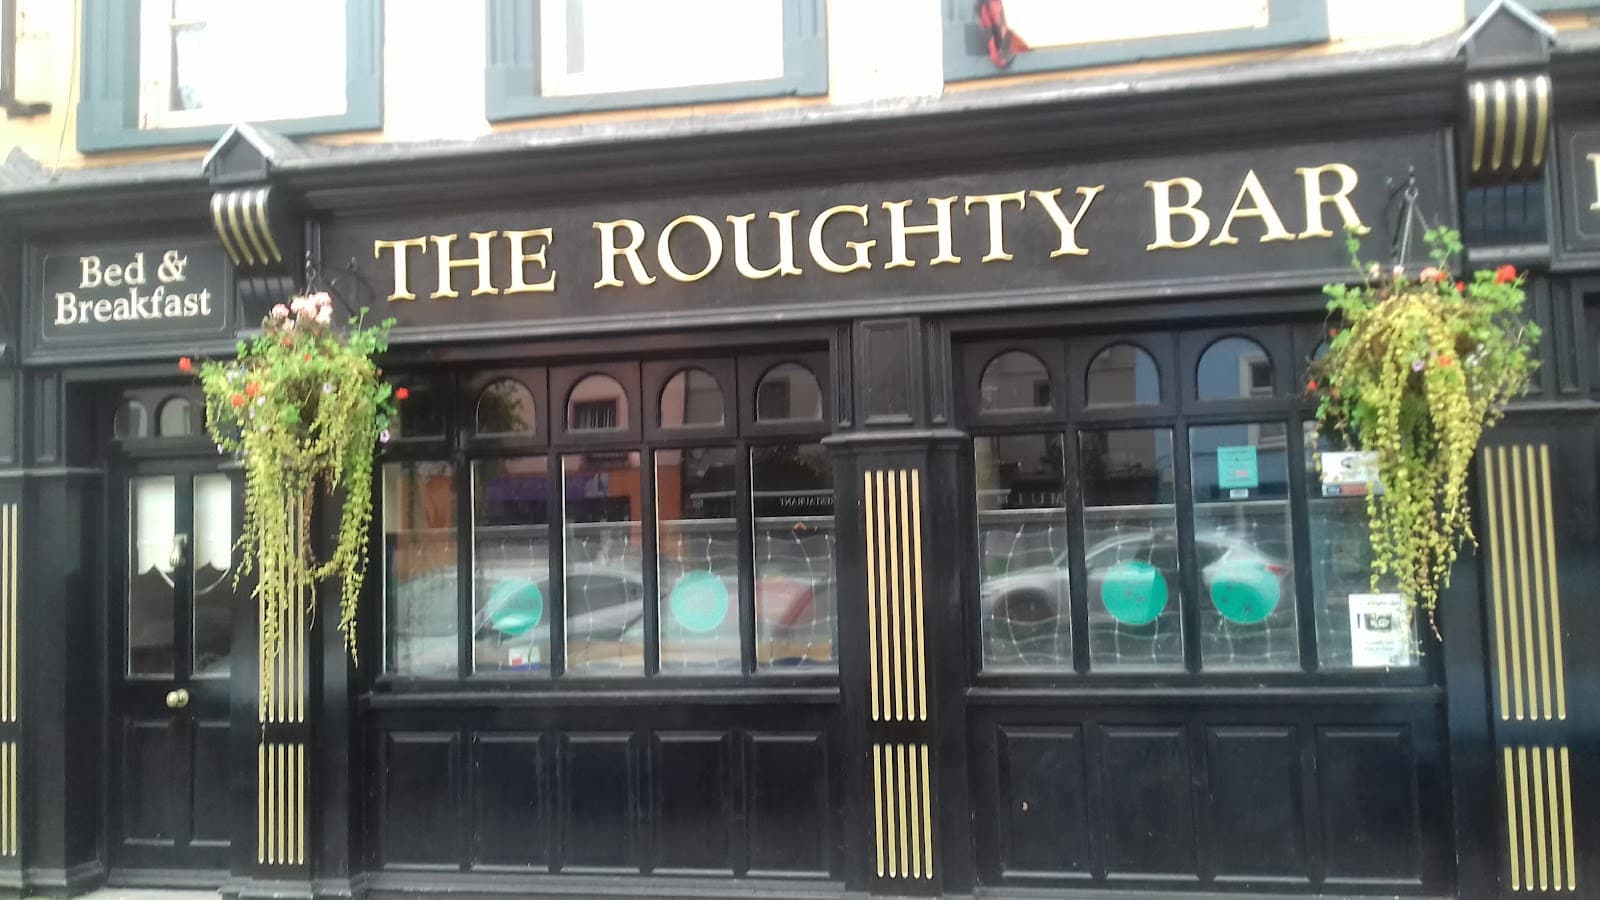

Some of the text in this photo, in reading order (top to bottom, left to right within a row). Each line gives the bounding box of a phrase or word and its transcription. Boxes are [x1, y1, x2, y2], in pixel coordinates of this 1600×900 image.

[374, 162, 1372, 302] THE ROUGHTY BAR
[79, 250, 188, 289] Bed &
[54, 286, 212, 326] Breakfast
